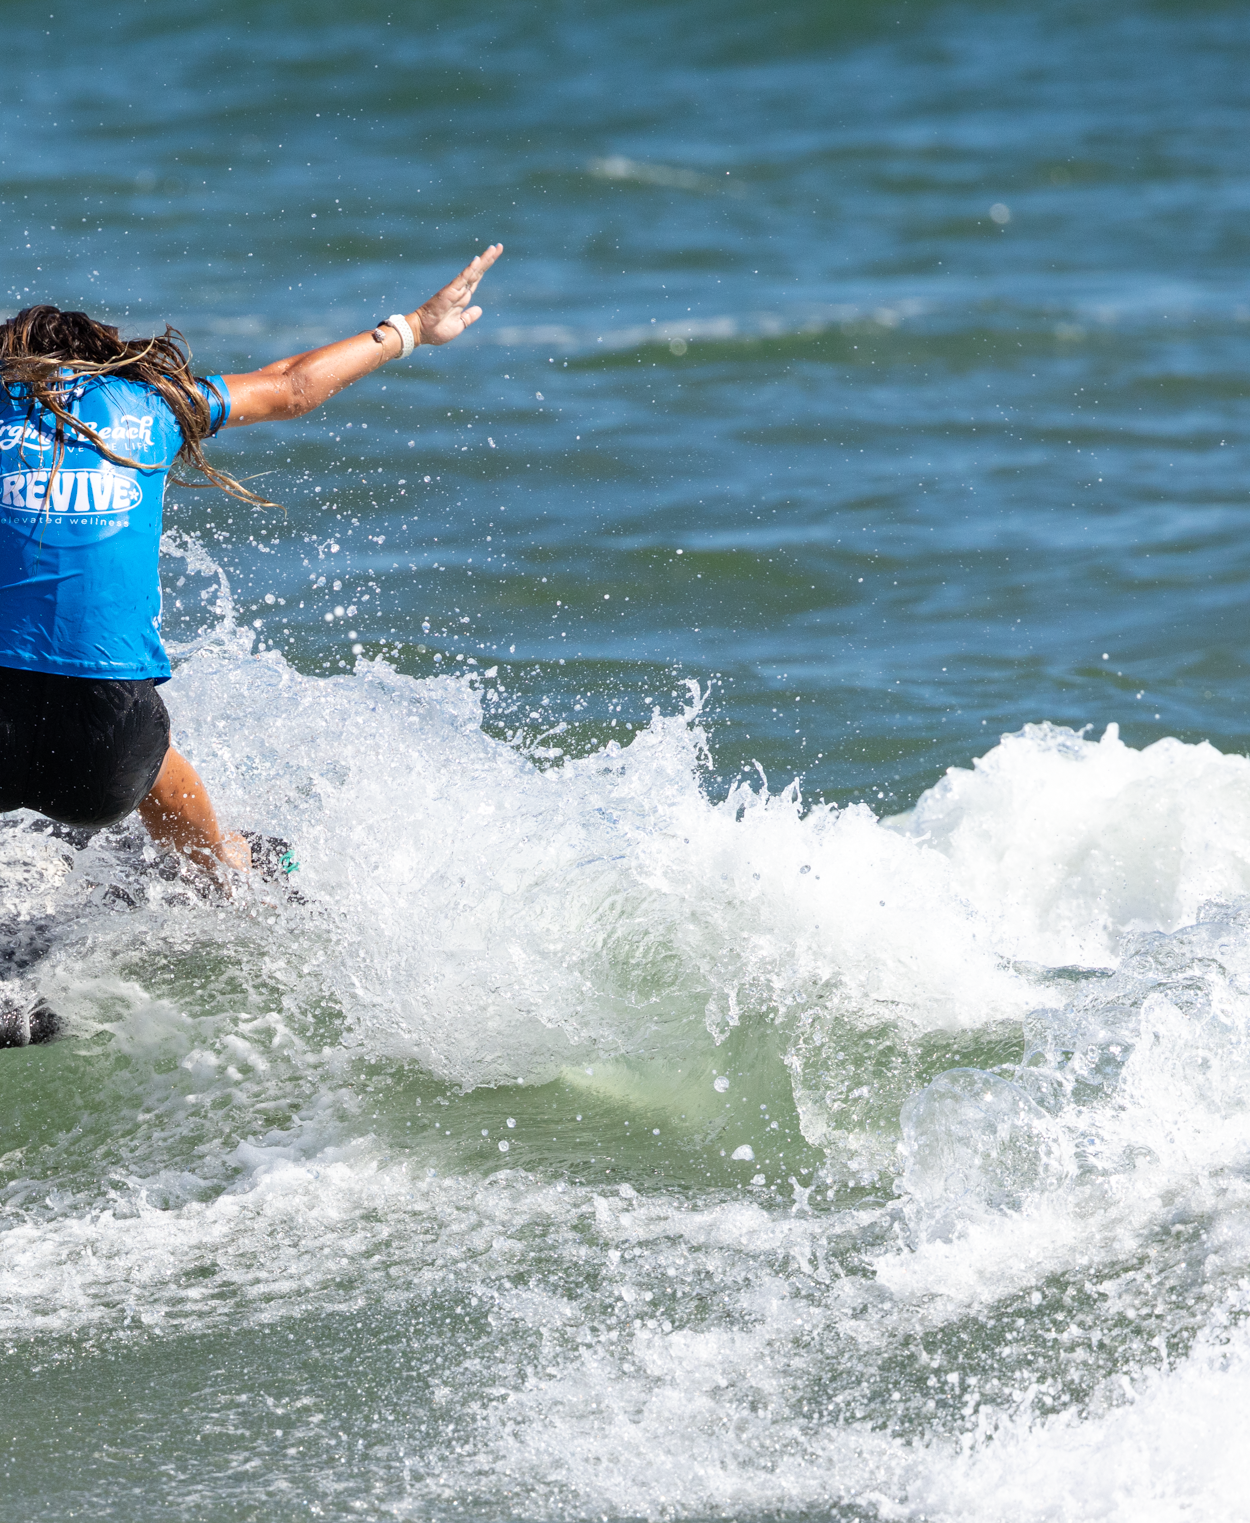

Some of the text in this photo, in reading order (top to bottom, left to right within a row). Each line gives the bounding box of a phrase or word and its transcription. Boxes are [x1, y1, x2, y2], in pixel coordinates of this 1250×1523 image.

[71, 414, 154, 446] Beach
[91, 442, 118, 451] TE
[124, 442, 149, 453] LIFE
[1, 471, 131, 512] REVIVE
[0, 516, 129, 528] elevated wellness
